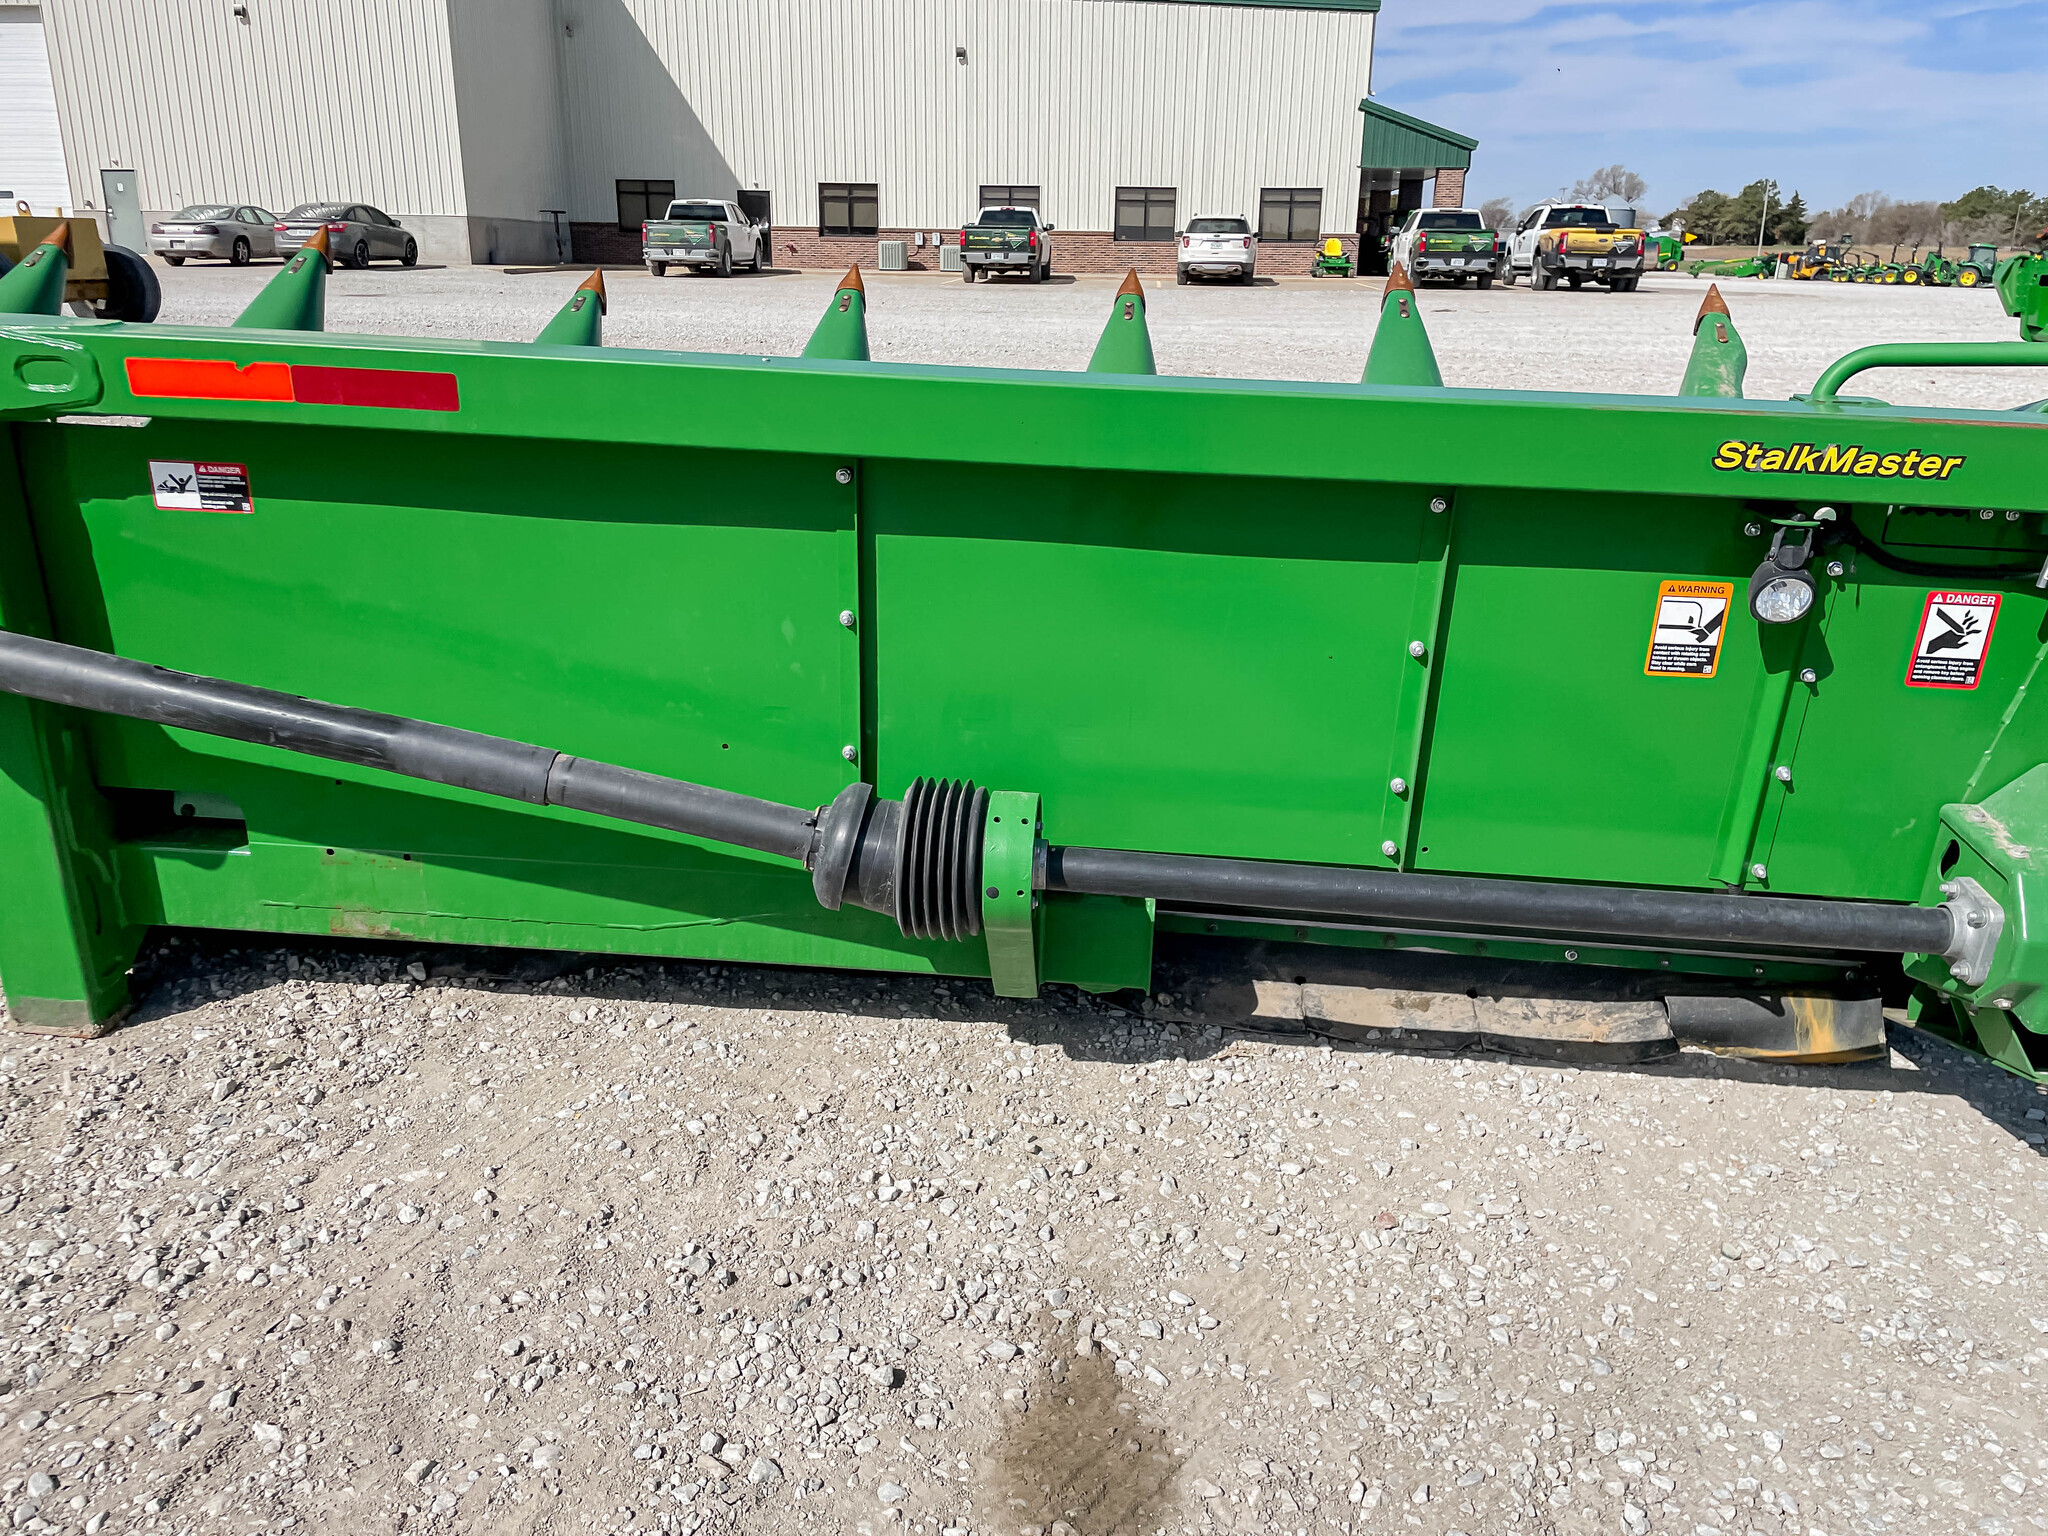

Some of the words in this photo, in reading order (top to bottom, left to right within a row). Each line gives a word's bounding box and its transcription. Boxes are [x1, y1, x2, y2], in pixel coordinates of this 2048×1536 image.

[1713, 440, 1965, 479] StalkMaster
[207, 466, 242, 474] DANGER
[1678, 585, 1726, 594] WARNING
[1946, 594, 1996, 605] DANGER
